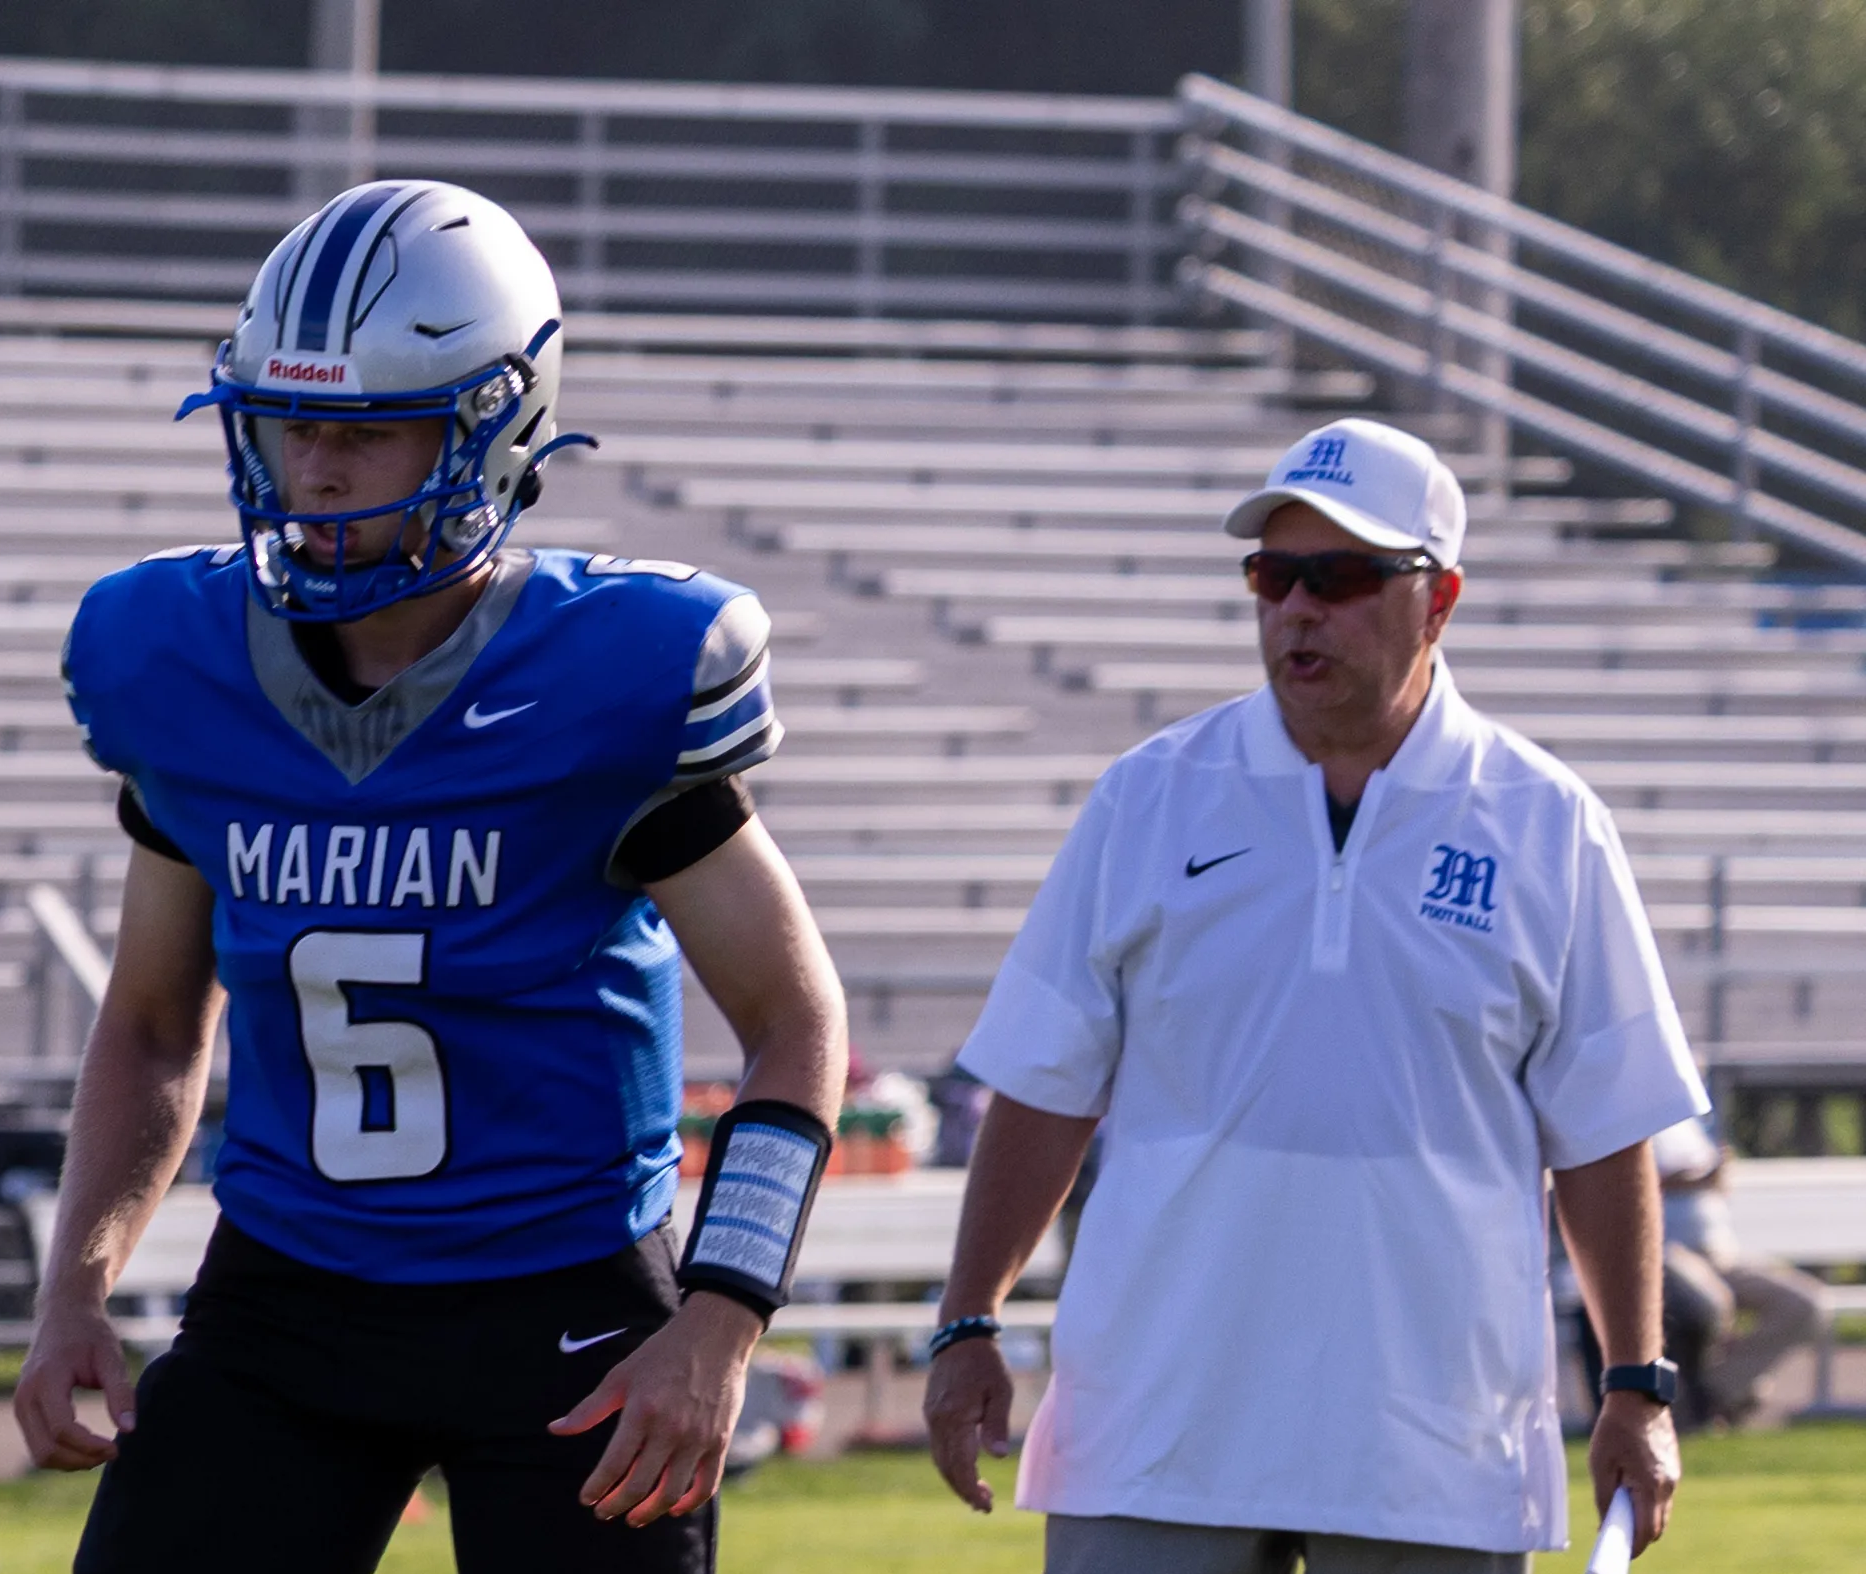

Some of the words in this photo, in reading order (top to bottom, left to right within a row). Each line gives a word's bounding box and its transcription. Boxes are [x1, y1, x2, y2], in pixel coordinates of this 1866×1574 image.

[268, 359, 346, 383] Riddell
[1282, 469, 1356, 487] FOOTBALL
[226, 822, 502, 908] MARIAN
[1424, 844, 1497, 912] M
[1420, 902, 1493, 933] FOOTBALL
[288, 929, 447, 1183] 6
